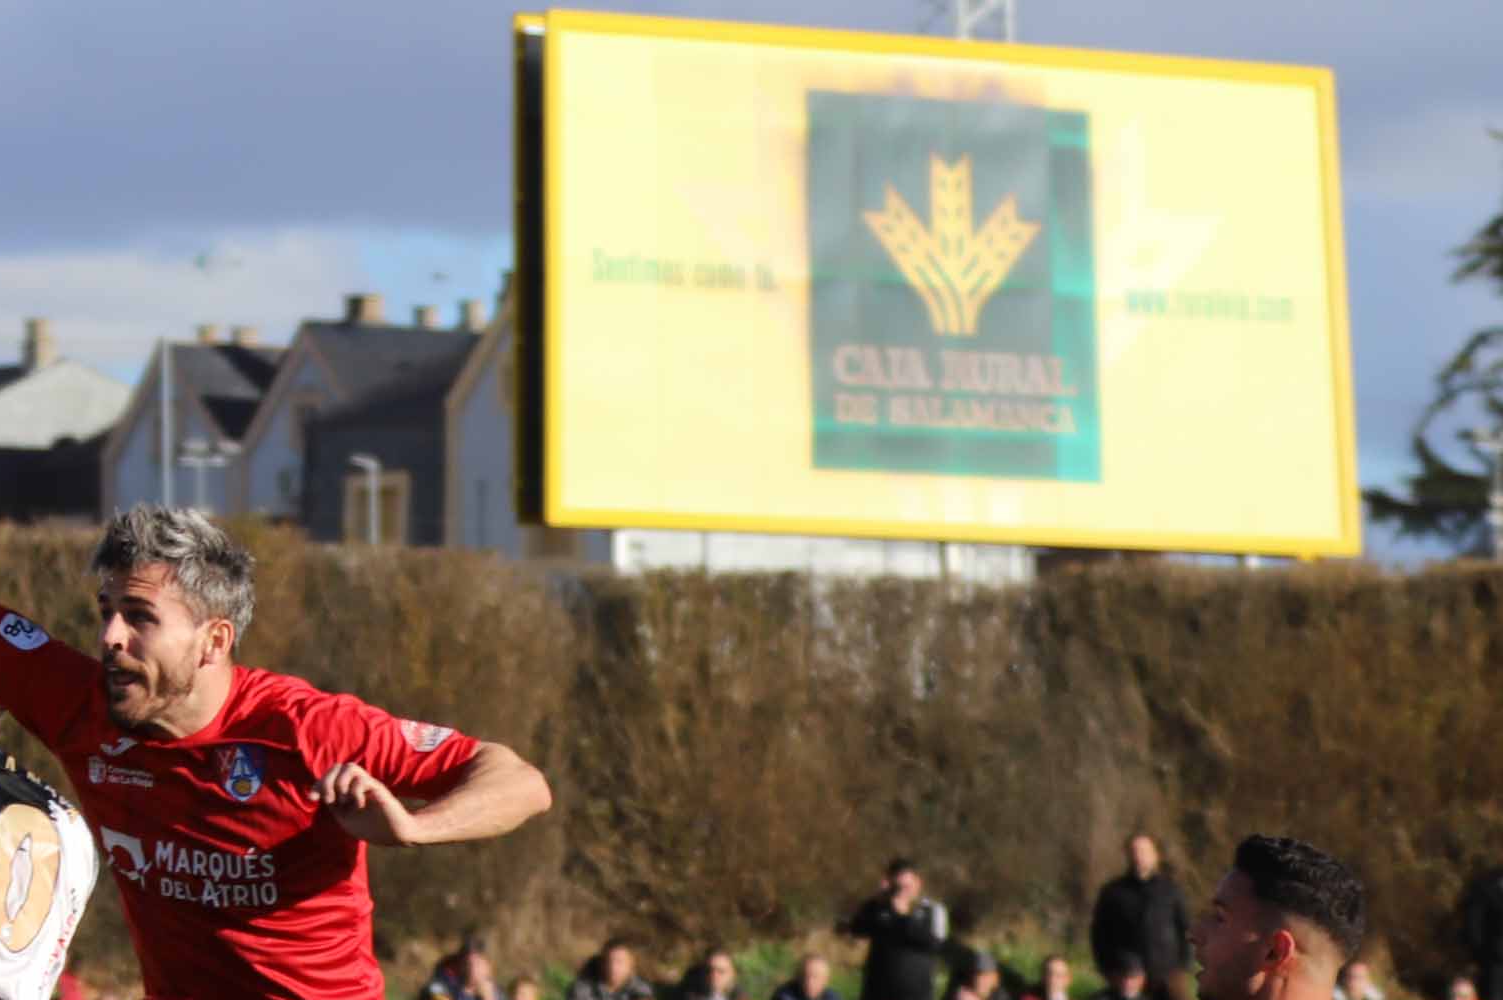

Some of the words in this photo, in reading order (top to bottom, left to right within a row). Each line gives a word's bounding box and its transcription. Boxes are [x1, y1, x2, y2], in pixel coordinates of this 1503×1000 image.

[832, 343, 933, 388] CAJA
[939, 348, 1080, 396] RURAL
[833, 392, 879, 425] DE
[888, 394, 1081, 434] SALAMANCA
[155, 840, 275, 881] MARQUÉS
[160, 877, 196, 901] DEL
[201, 878, 278, 908] ATRIO
